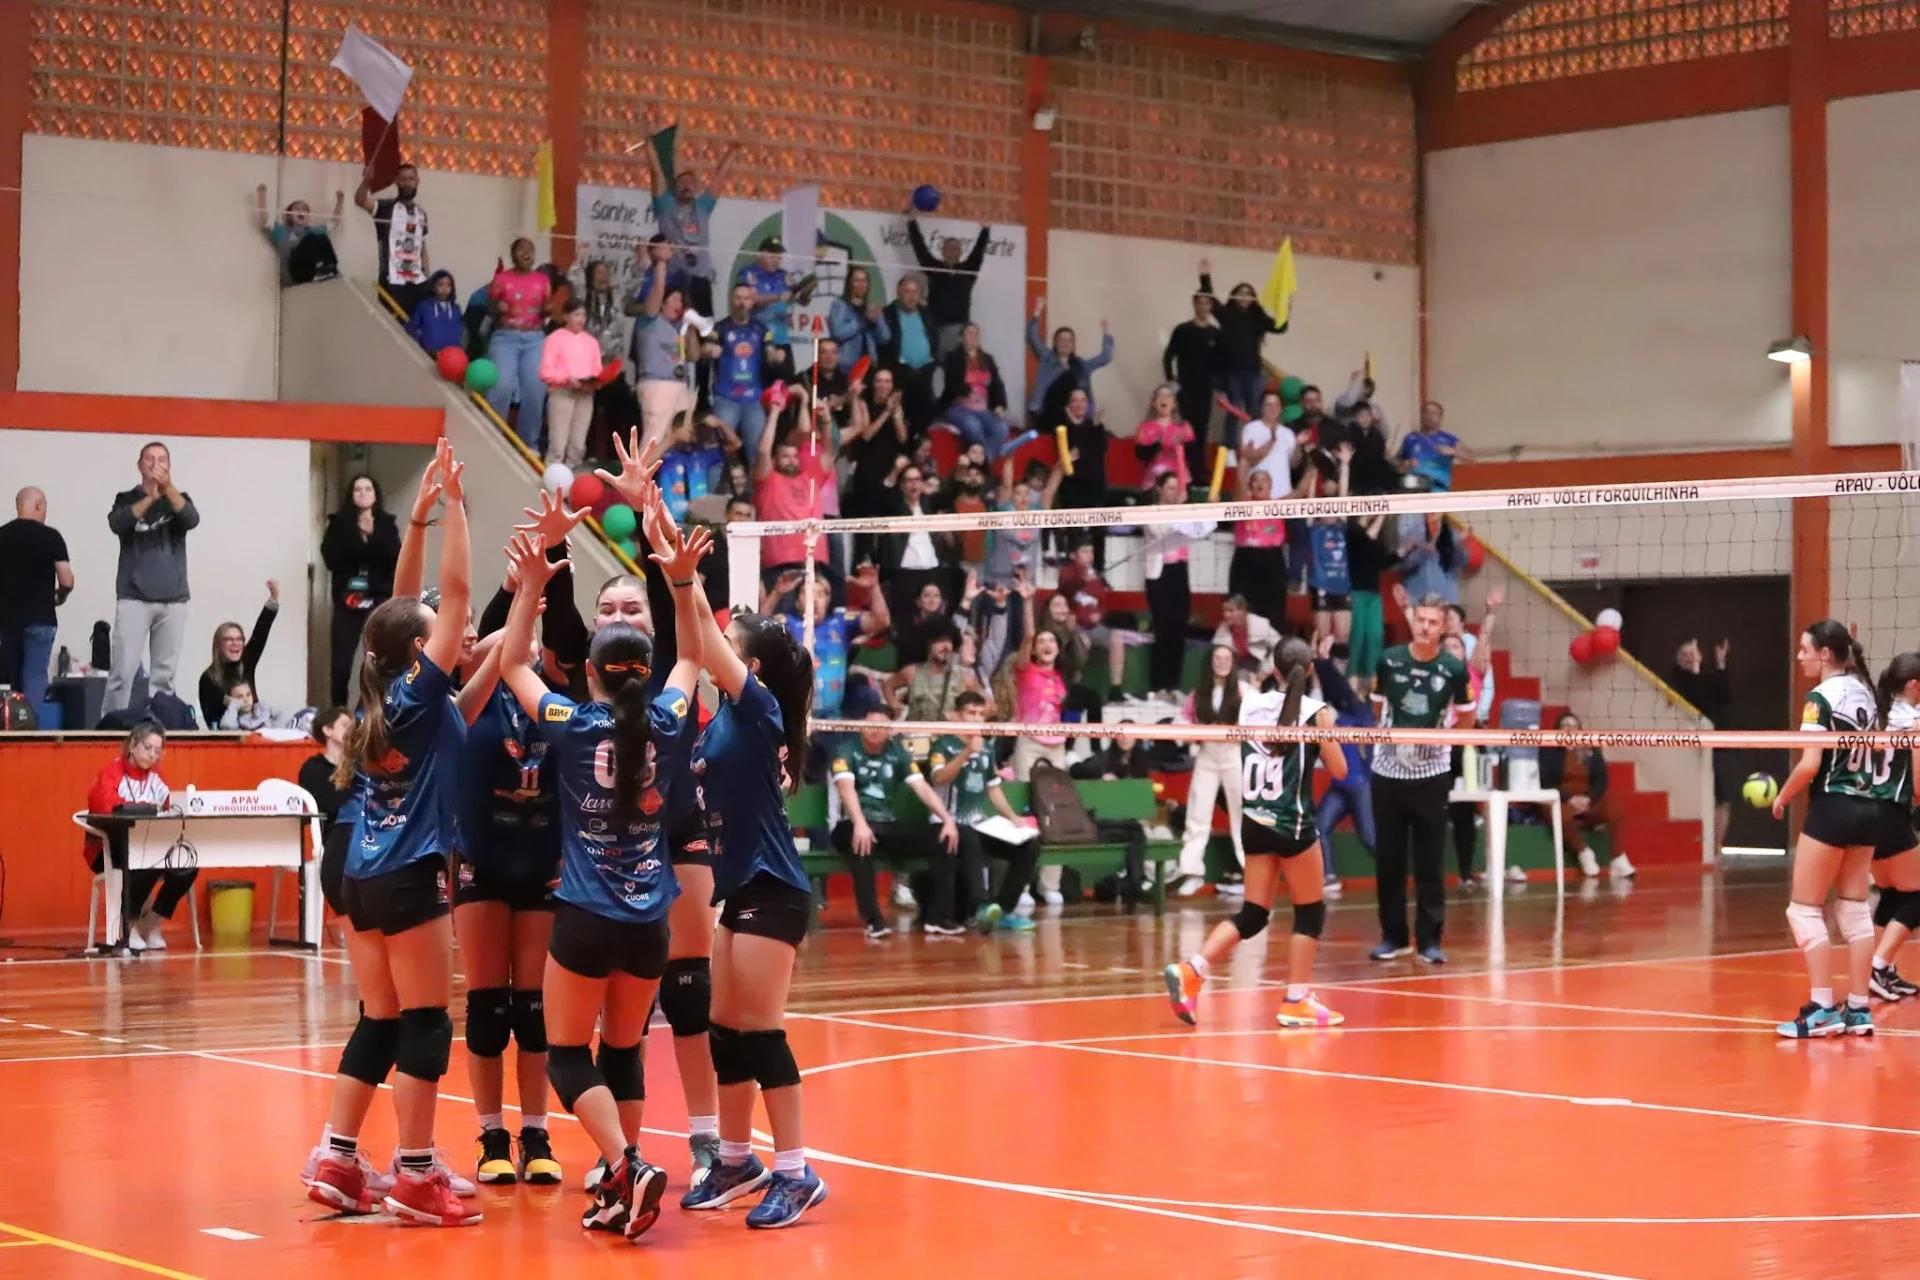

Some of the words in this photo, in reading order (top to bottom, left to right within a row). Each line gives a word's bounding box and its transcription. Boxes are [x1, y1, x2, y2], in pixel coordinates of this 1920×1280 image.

[1835, 477, 1873, 493] APAV
[1888, 472, 1920, 491] VÔL
[1507, 493, 1541, 507] APAV
[1595, 486, 1699, 504] FORQUILHINHA
[1224, 506, 1253, 518] APAV
[1300, 500, 1390, 515] FORQUILHINHA
[1045, 511, 1122, 526] FORQUILHINHA
[1510, 733, 1543, 745] APAV
[1599, 733, 1701, 747] FORQUILHINHA
[1838, 735, 1876, 749] APAV
[1243, 753, 1284, 801] 09
[231, 796, 260, 805] APAV
[213, 804, 278, 813] FORQUILHINHA
